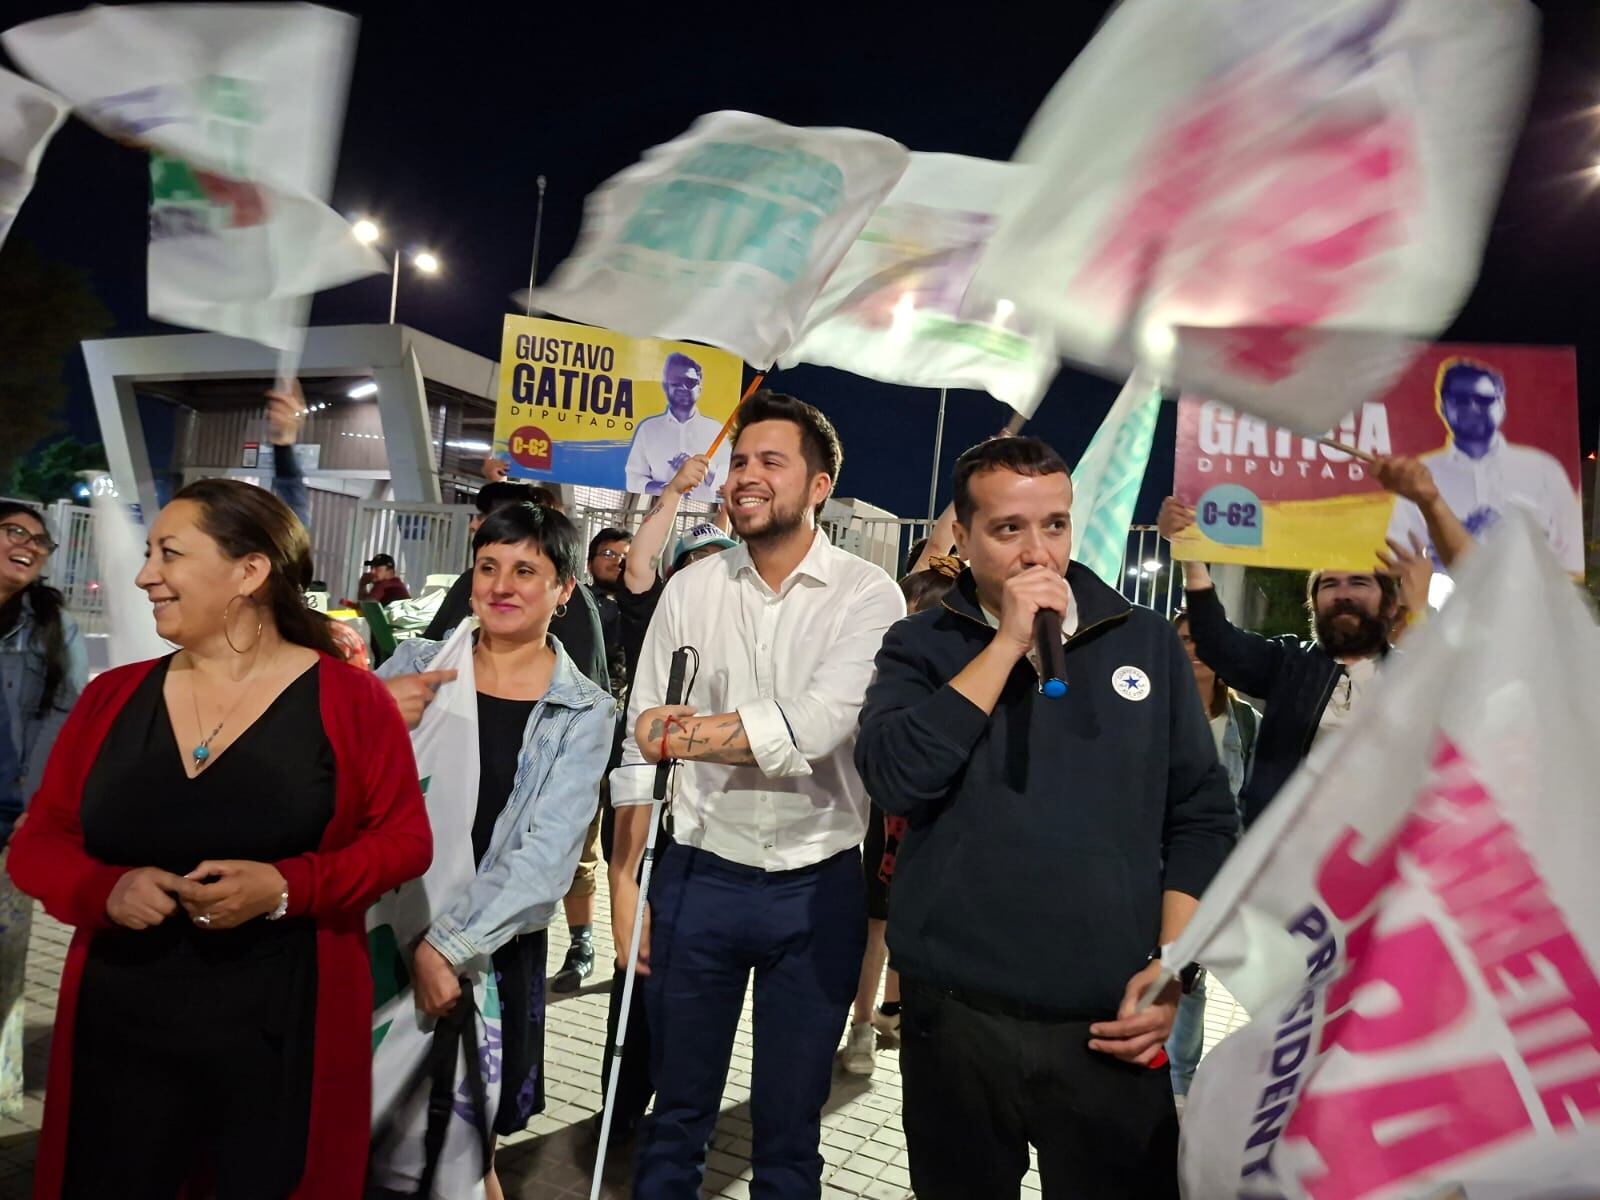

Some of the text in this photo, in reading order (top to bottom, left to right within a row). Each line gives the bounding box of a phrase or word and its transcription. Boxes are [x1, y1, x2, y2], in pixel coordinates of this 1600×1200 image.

[516, 334, 615, 372] GUSTAVO
[512, 363, 633, 418] GATICA
[511, 406, 634, 431] DIPUTADO
[513, 436, 549, 458] C-62
[1198, 457, 1364, 480] DIPUTAD
[1203, 501, 1257, 527] C-62
[1237, 902, 1337, 1200] PRSIDENT
